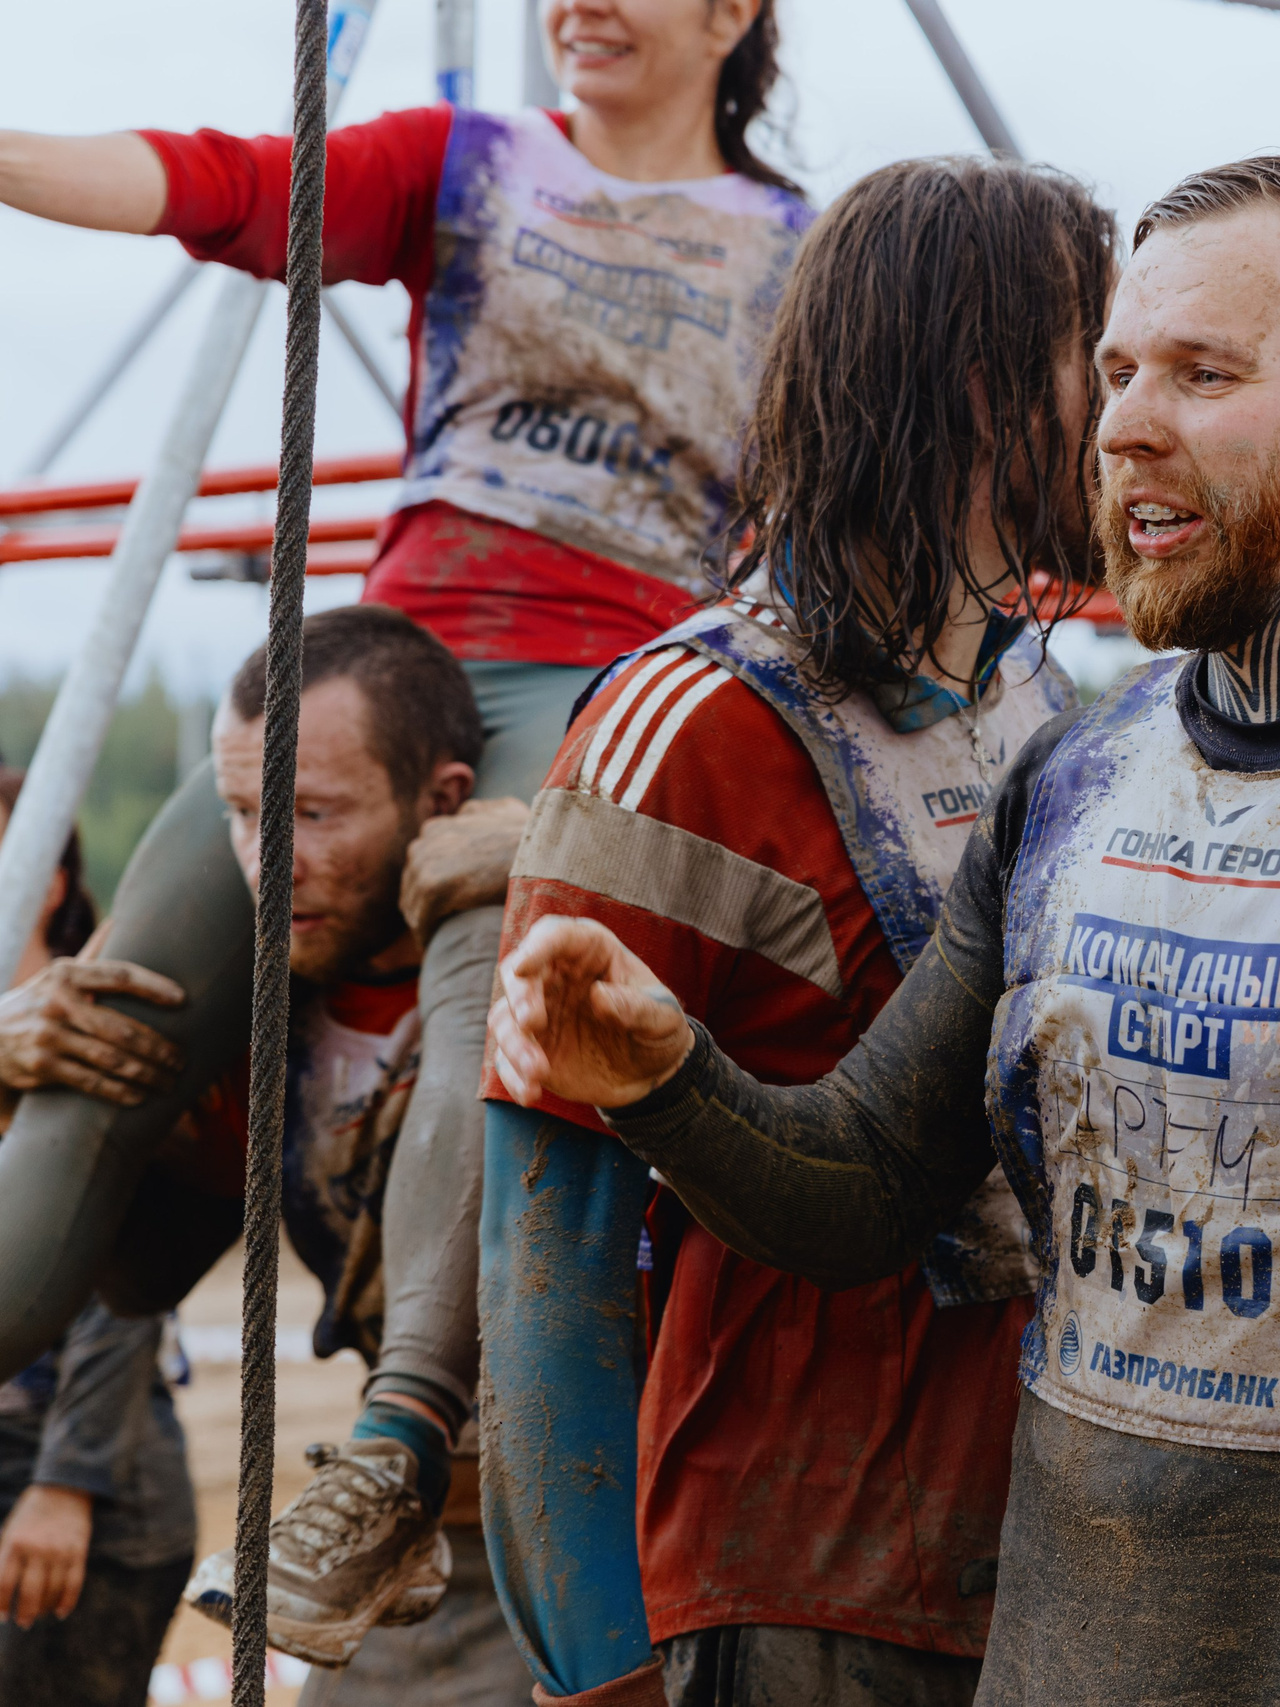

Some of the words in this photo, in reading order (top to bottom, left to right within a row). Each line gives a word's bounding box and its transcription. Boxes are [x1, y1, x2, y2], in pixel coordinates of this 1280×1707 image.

[921, 783, 994, 818] ГОНК
[1104, 827, 1194, 869] ГОНКА
[1069, 1181, 1274, 1320] 01510
[1089, 1341, 1280, 1408] ГАЗПРОМБАНК
